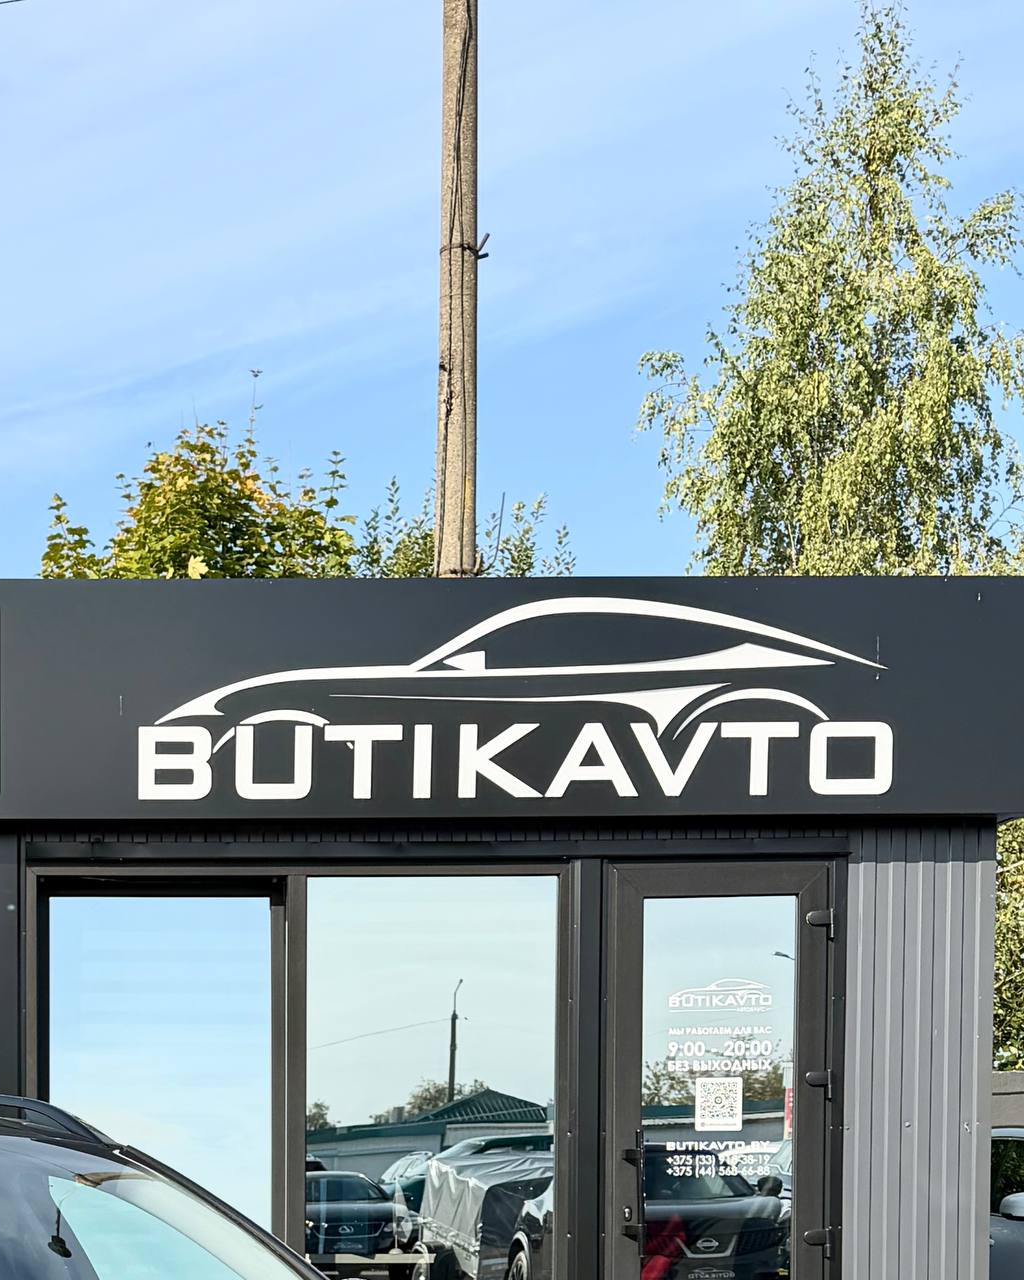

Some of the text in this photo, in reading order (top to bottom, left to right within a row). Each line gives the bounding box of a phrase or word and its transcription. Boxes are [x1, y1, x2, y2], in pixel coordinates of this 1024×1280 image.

[138, 721, 894, 800] BUTIKAVTO
[668, 994, 772, 1007] BUTIKAVTO
[668, 1026, 772, 1035] МЫ РАБОТАЕМ ДЛЯ ВАС
[668, 1041, 705, 1056] 9:00
[723, 1040, 772, 1056] 20:00
[667, 1059, 772, 1072] БЕЗ ВЫХОДНЫХ
[666, 1141, 770, 1151] BUTIKAVTO.BY
[666, 1155, 693, 1166] +375
[695, 1154, 716, 1167] (33)
[666, 1166, 771, 1178] +375 (44) 568-66-88
